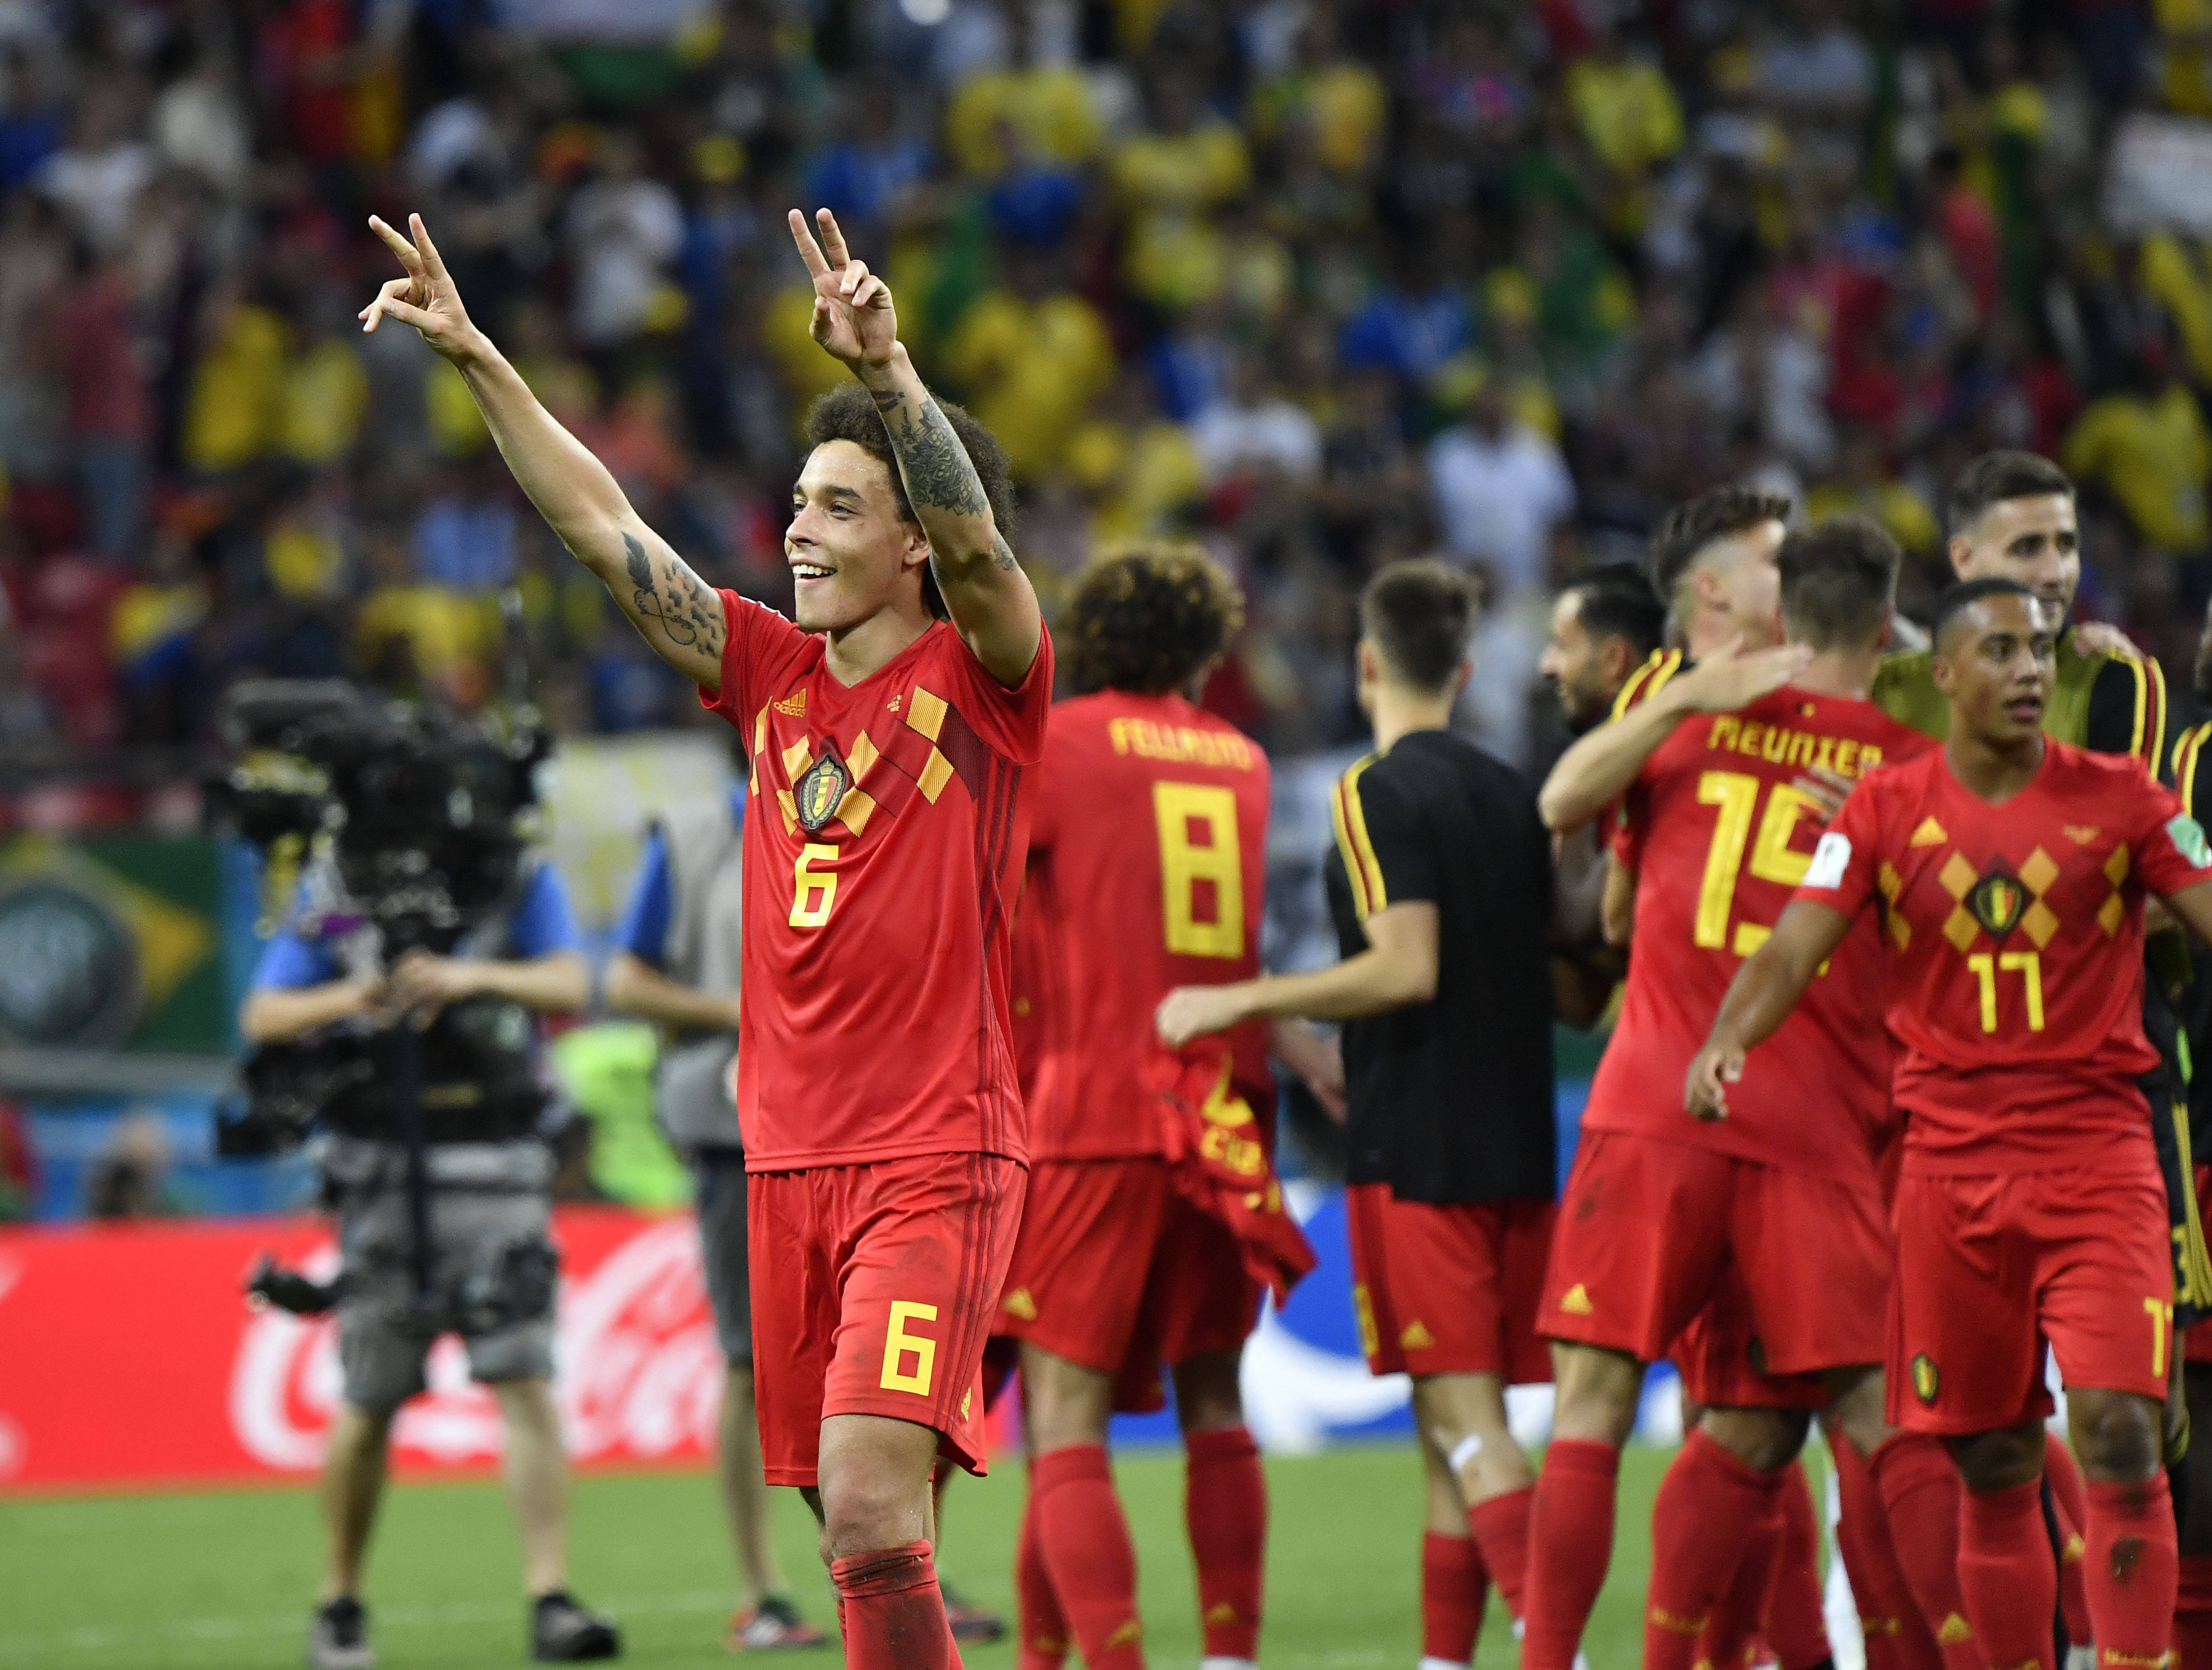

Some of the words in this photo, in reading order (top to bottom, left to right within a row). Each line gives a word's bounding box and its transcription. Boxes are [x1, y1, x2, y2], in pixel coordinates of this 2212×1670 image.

[789, 844, 839, 927] 6
[1153, 780, 1243, 960] 8
[1968, 951, 2045, 1032] 17
[880, 1300, 937, 1396] 6
[2143, 1296, 2174, 1378] 1
